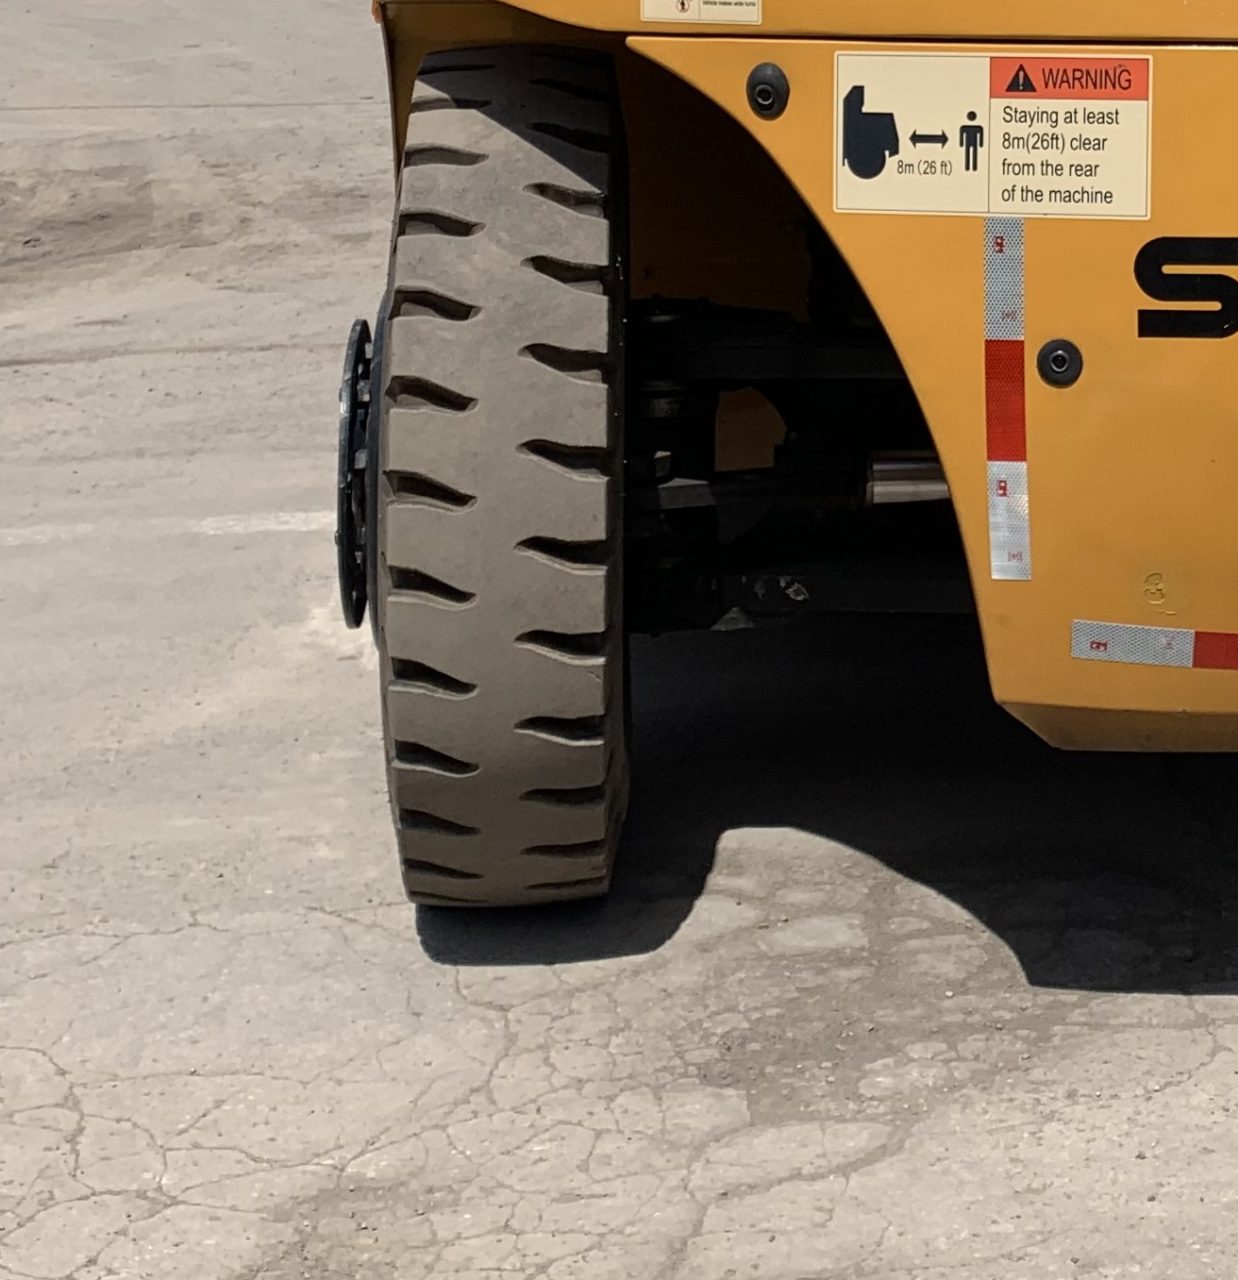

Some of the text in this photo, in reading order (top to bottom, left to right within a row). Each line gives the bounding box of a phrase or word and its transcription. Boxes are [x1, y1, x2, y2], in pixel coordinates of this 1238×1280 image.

[1042, 67, 1133, 91] WARNING
[1002, 106, 1120, 128] Staying at least
[1002, 132, 1107, 153] 8m(26ft) clear
[897, 160, 953, 176] 8m (26 ft)
[1001, 158, 1099, 177] from the rear
[1001, 185, 1113, 204] of the machine
